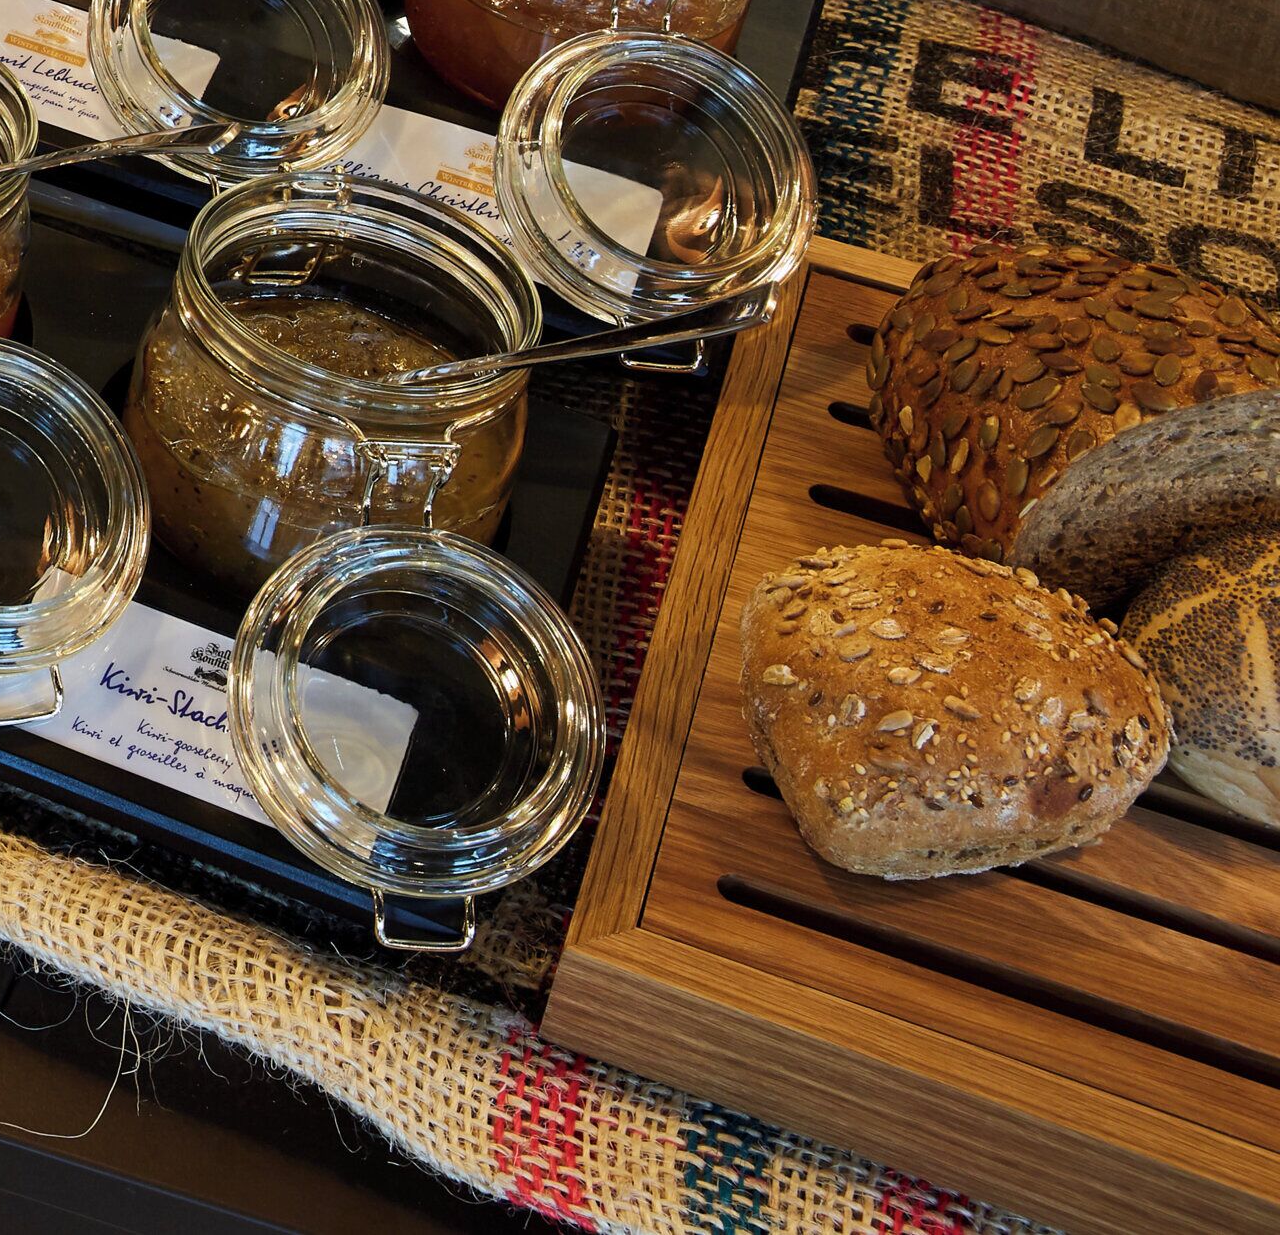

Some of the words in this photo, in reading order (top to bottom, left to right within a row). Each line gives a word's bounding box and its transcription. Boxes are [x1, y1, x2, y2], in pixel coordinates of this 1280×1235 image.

[99, 662, 231, 734] Kiwi-Stach
[72, 716, 103, 740] Kiwi
[109, 734, 123, 747] et
[128, 744, 187, 773] groseilles
[195, 767, 205, 779] à
[137, 719, 234, 773] Kiwi-gooseberry
